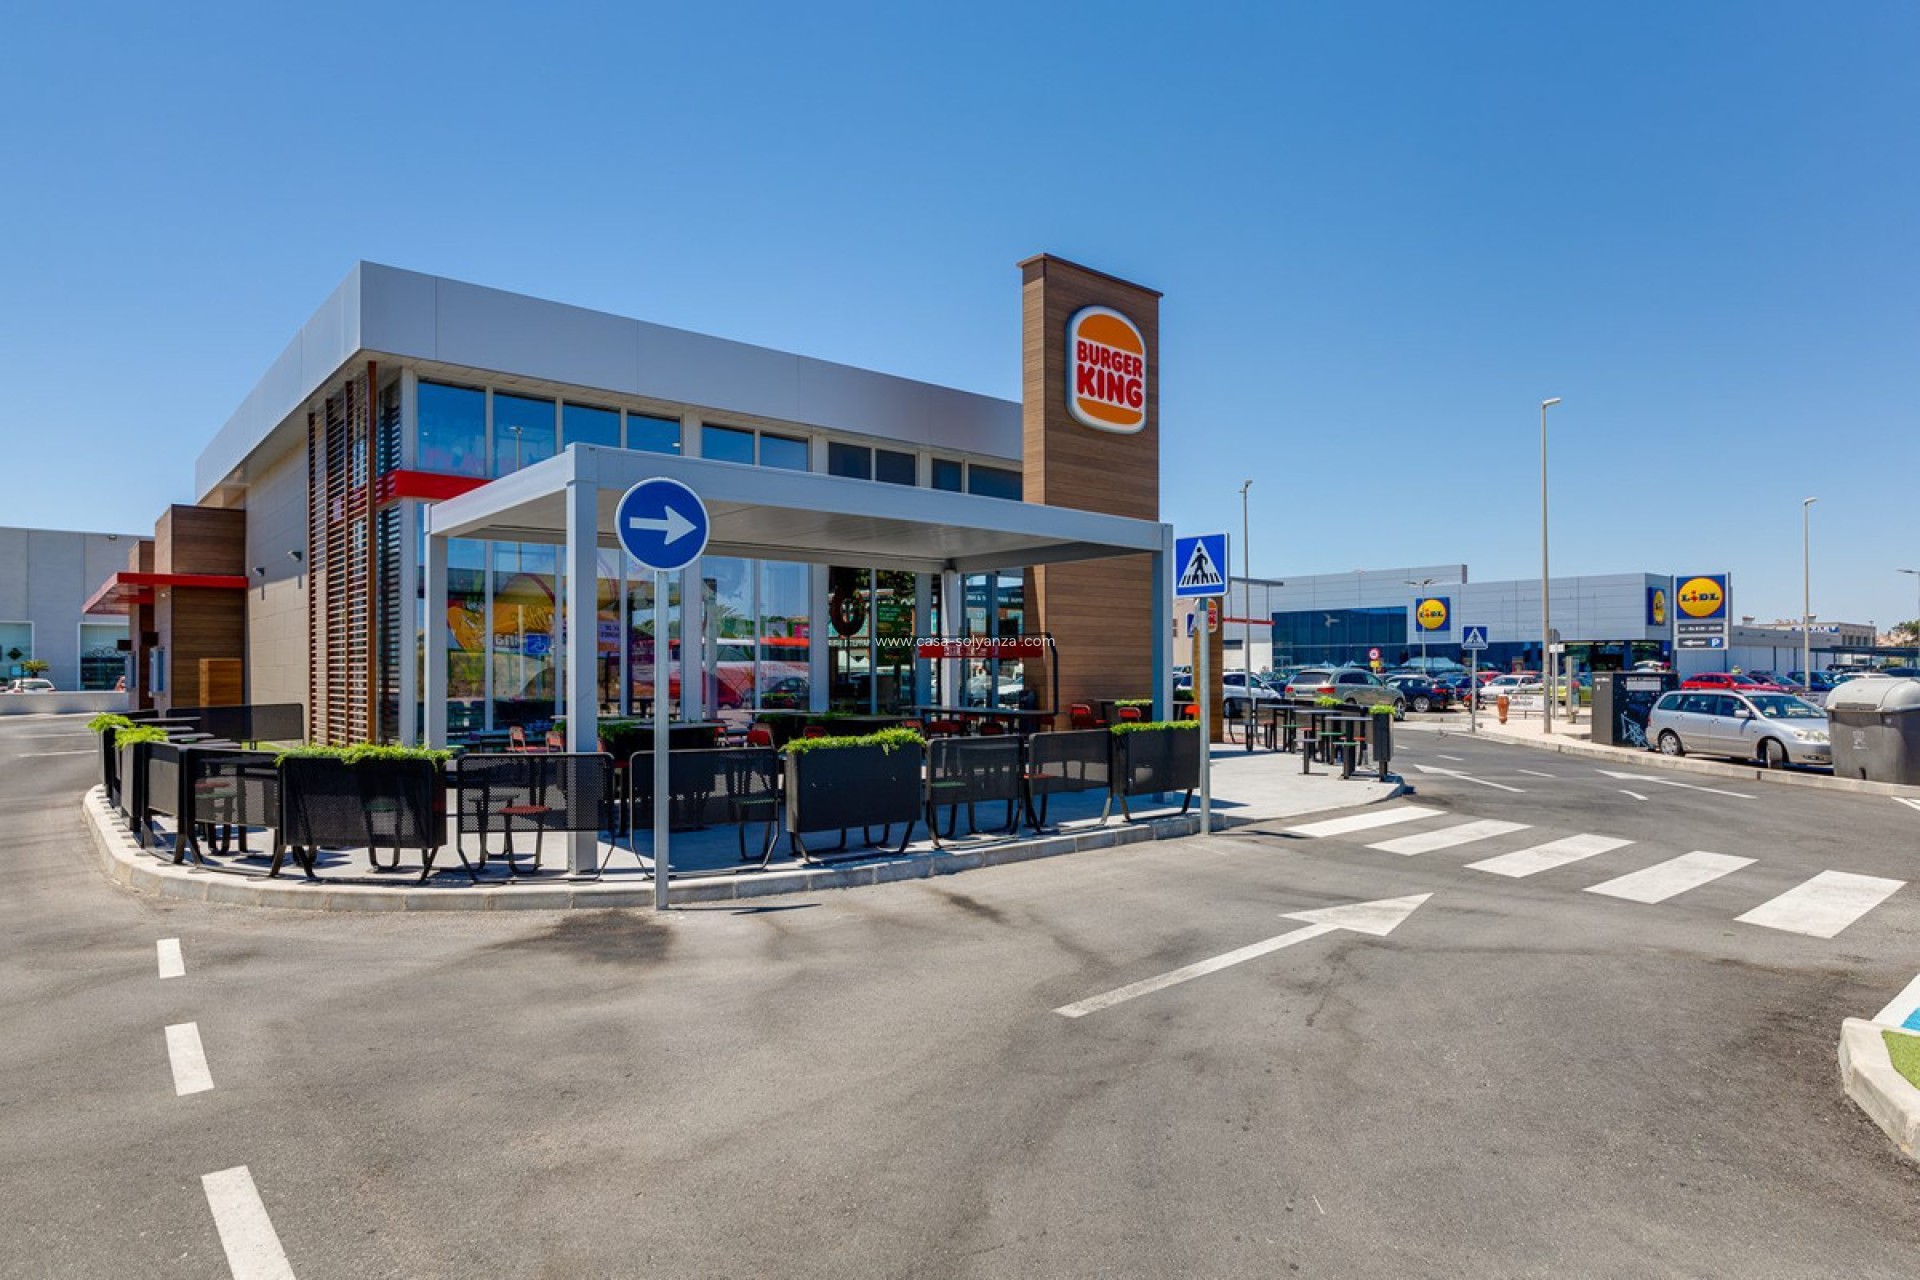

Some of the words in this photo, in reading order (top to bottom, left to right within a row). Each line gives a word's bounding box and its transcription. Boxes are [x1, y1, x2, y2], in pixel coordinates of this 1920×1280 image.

[1076, 340, 1143, 378] BURGER
[1076, 365, 1143, 409] KING
[1711, 638, 1721, 648] P
